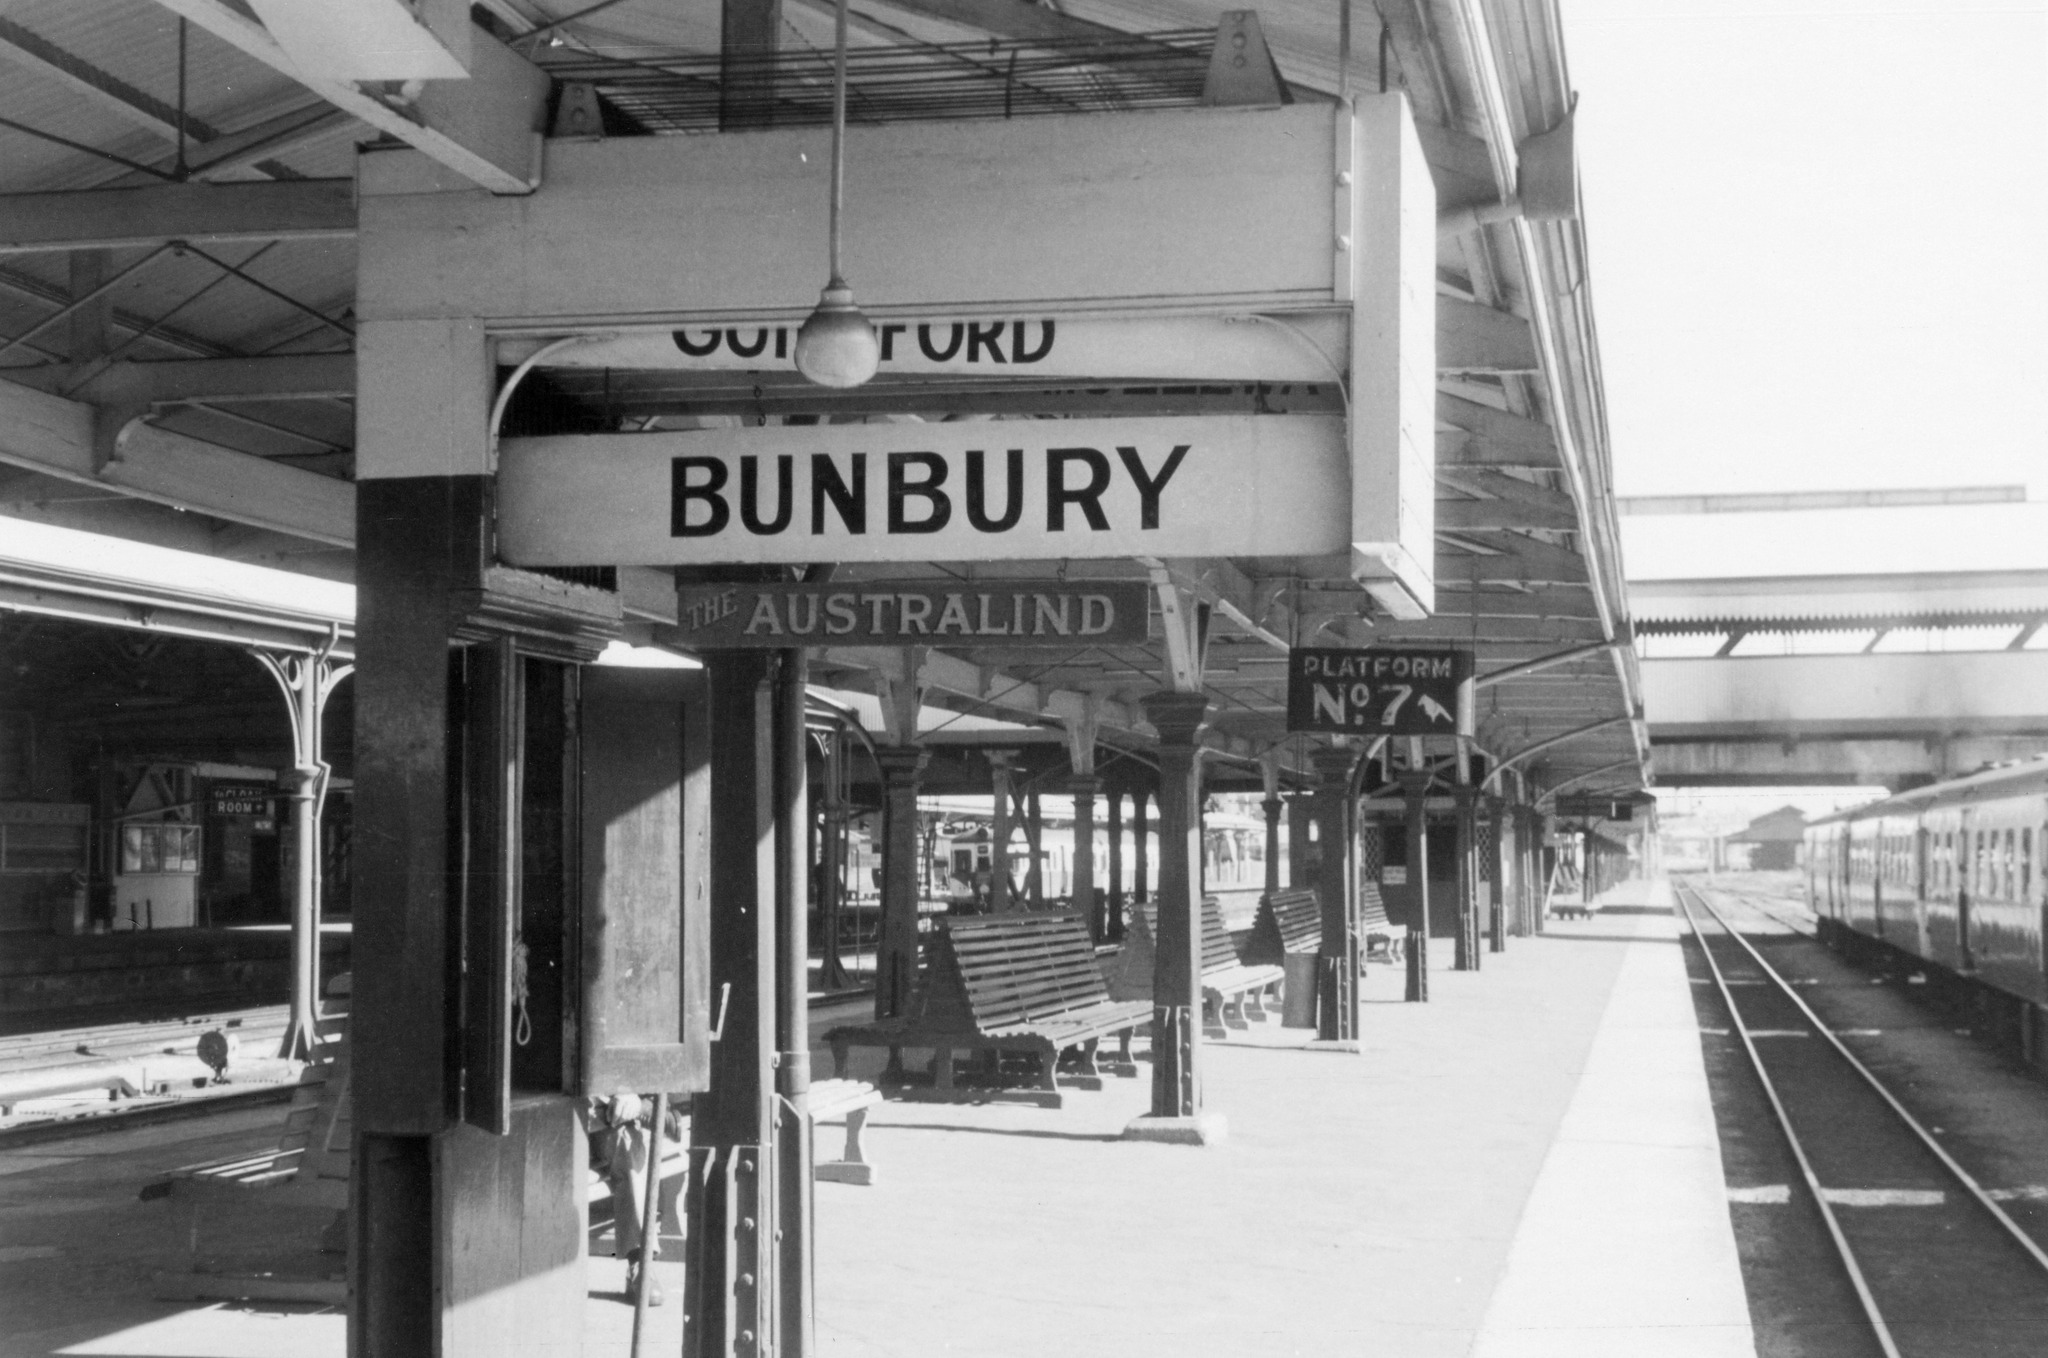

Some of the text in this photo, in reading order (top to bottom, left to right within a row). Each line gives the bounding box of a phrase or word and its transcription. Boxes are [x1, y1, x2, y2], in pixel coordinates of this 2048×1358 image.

[671, 319, 1056, 364] GUIFORD
[669, 444, 1192, 538] BUNBURY
[686, 589, 1114, 635] THE AUSTRALIND
[1303, 655, 1453, 678] PLATFORM
[1377, 684, 1413, 726] 7
[218, 801, 252, 813] ROOM
